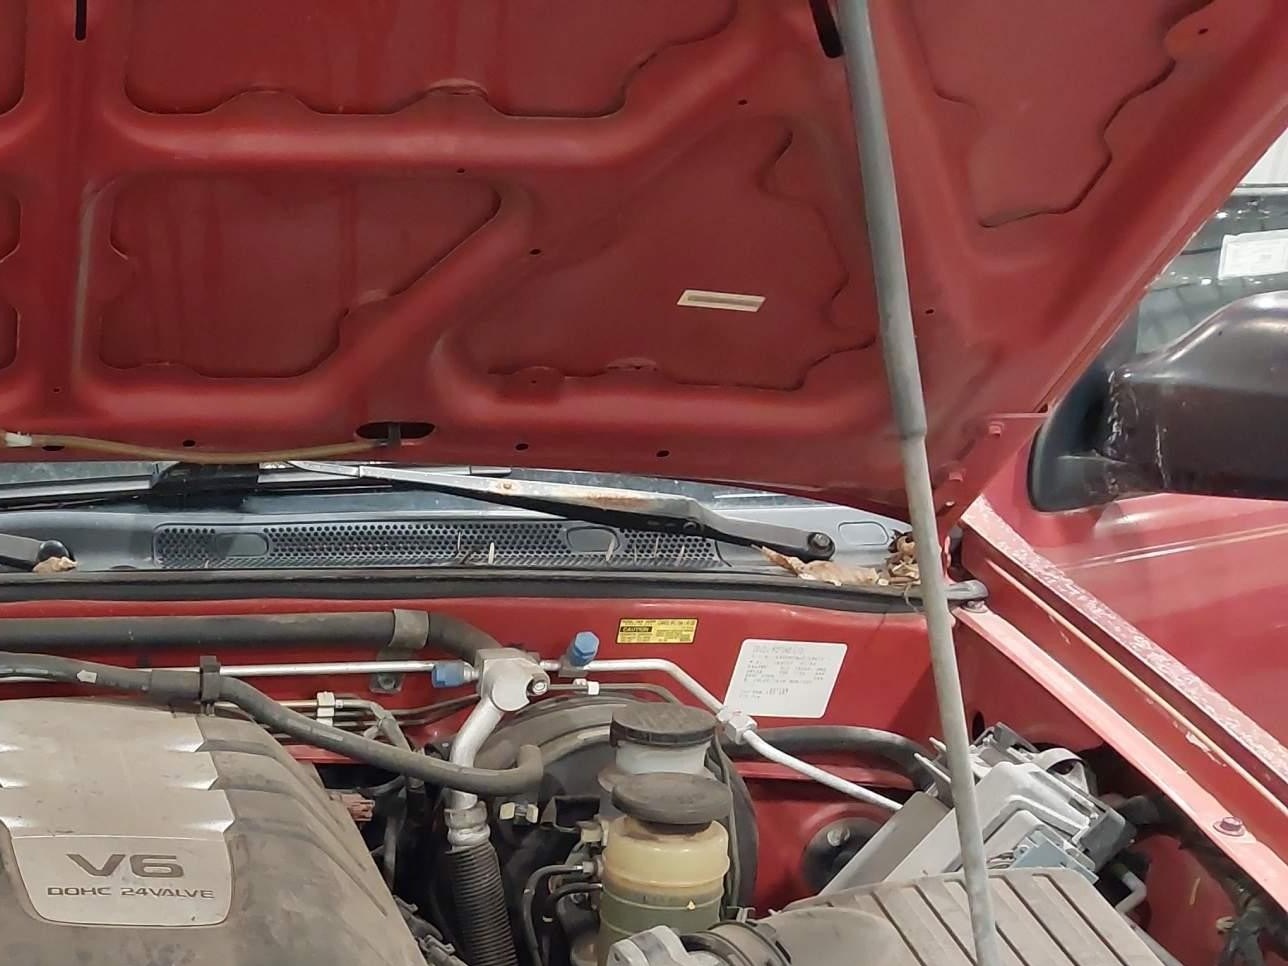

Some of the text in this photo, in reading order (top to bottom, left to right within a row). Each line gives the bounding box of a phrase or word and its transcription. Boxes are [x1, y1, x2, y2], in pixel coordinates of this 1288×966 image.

[66, 854, 184, 878] V6
[47, 887, 215, 899] DOHC 24VALVE
